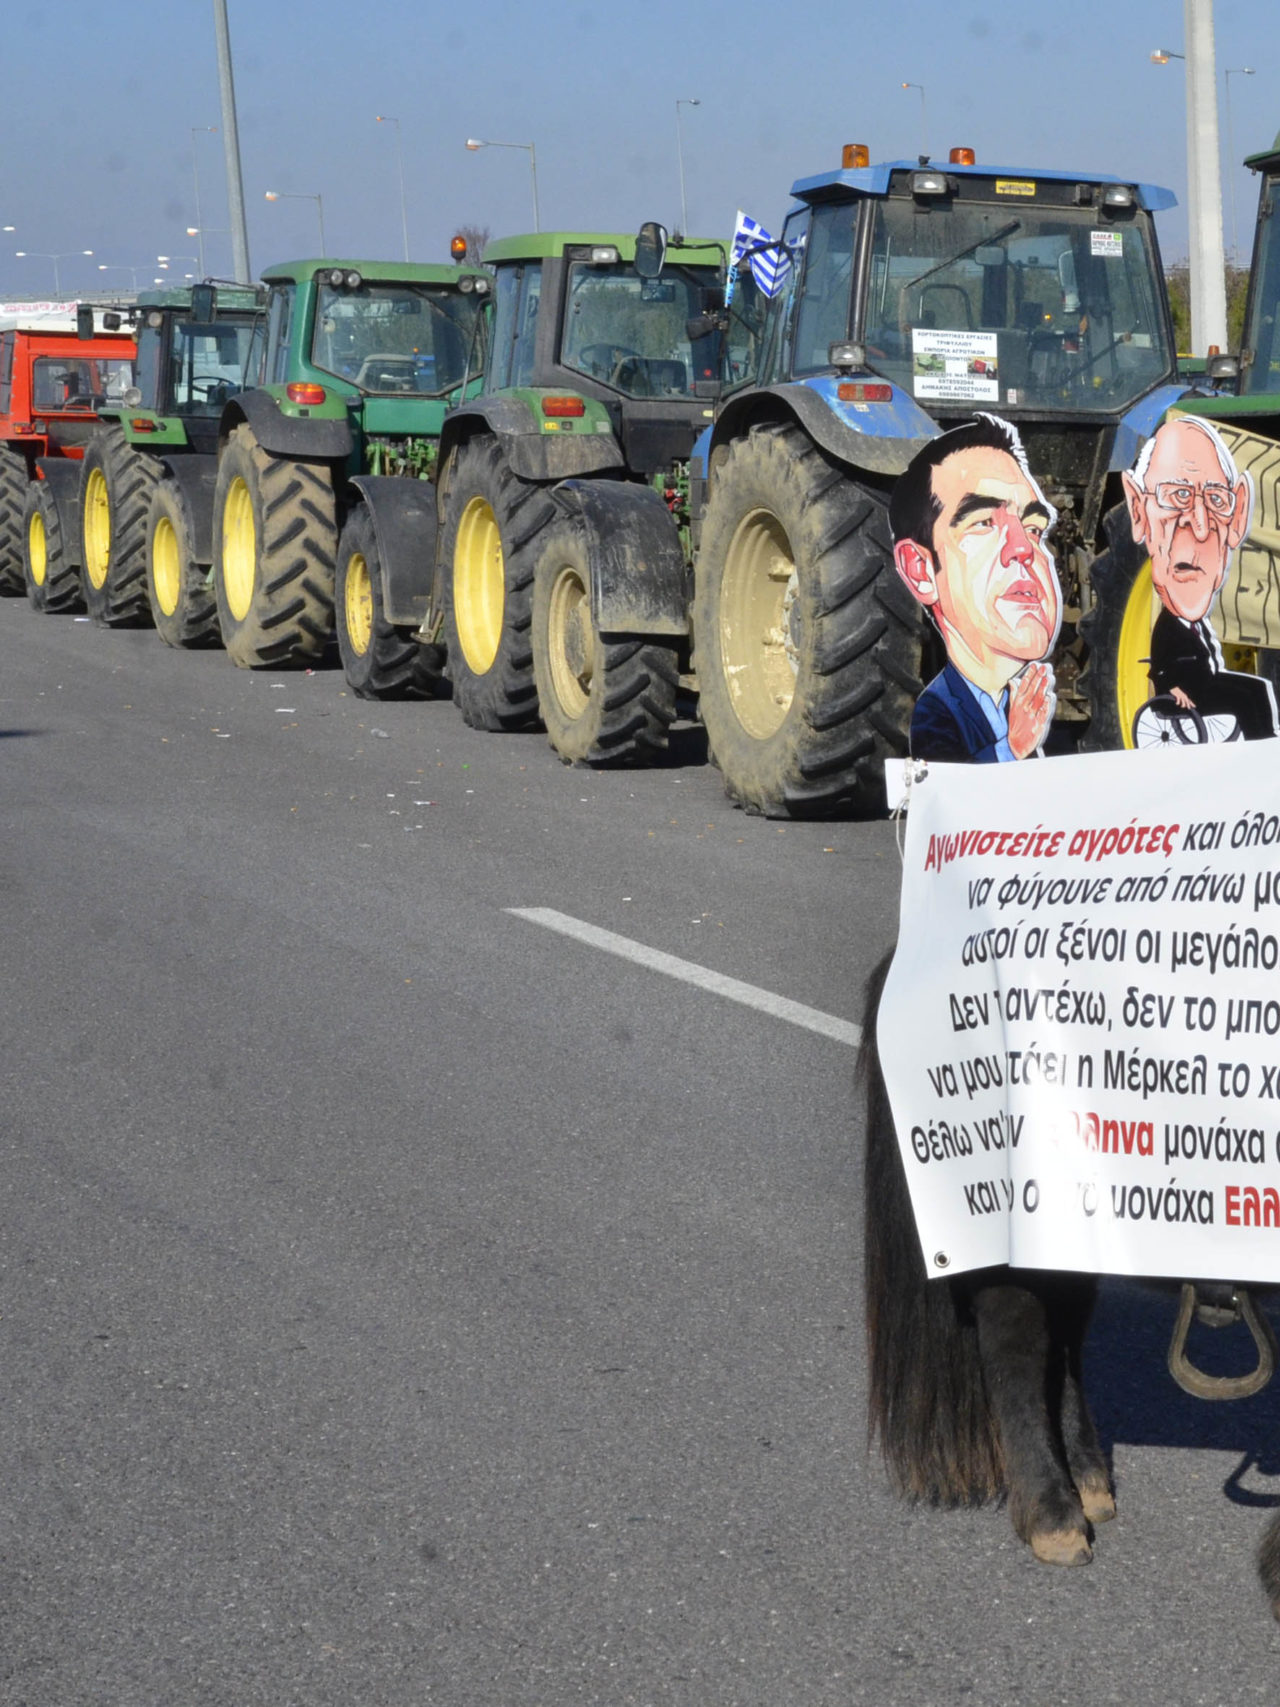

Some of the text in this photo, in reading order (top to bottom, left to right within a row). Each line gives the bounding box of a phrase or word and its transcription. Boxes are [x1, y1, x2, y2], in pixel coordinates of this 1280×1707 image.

[924, 825, 1065, 873] Αγωνιστείτε
[1066, 817, 1181, 862] αγρότες
[1182, 820, 1224, 852] και
[967, 876, 994, 911] να
[996, 871, 1113, 912] φύγουνε
[1113, 866, 1169, 904] από
[1170, 864, 1246, 905] πάνω
[960, 919, 1024, 968] αυτοί
[1023, 926, 1048, 961] οι
[1054, 917, 1128, 969] ξένοι
[1134, 927, 1162, 964] οι
[948, 991, 991, 1034] Δεν
[1121, 984, 1175, 1031] δεν
[1182, 995, 1218, 1033] το
[925, 1062, 961, 1100] να
[963, 1052, 1004, 1102] μου
[1076, 1053, 1094, 1089] η
[1102, 1045, 1209, 1101] Μέρκελ
[1216, 1061, 1252, 1100] το
[909, 1118, 975, 1165] Θέλω
[1163, 1115, 1267, 1167] μονάχα
[962, 1178, 1001, 1217] και
